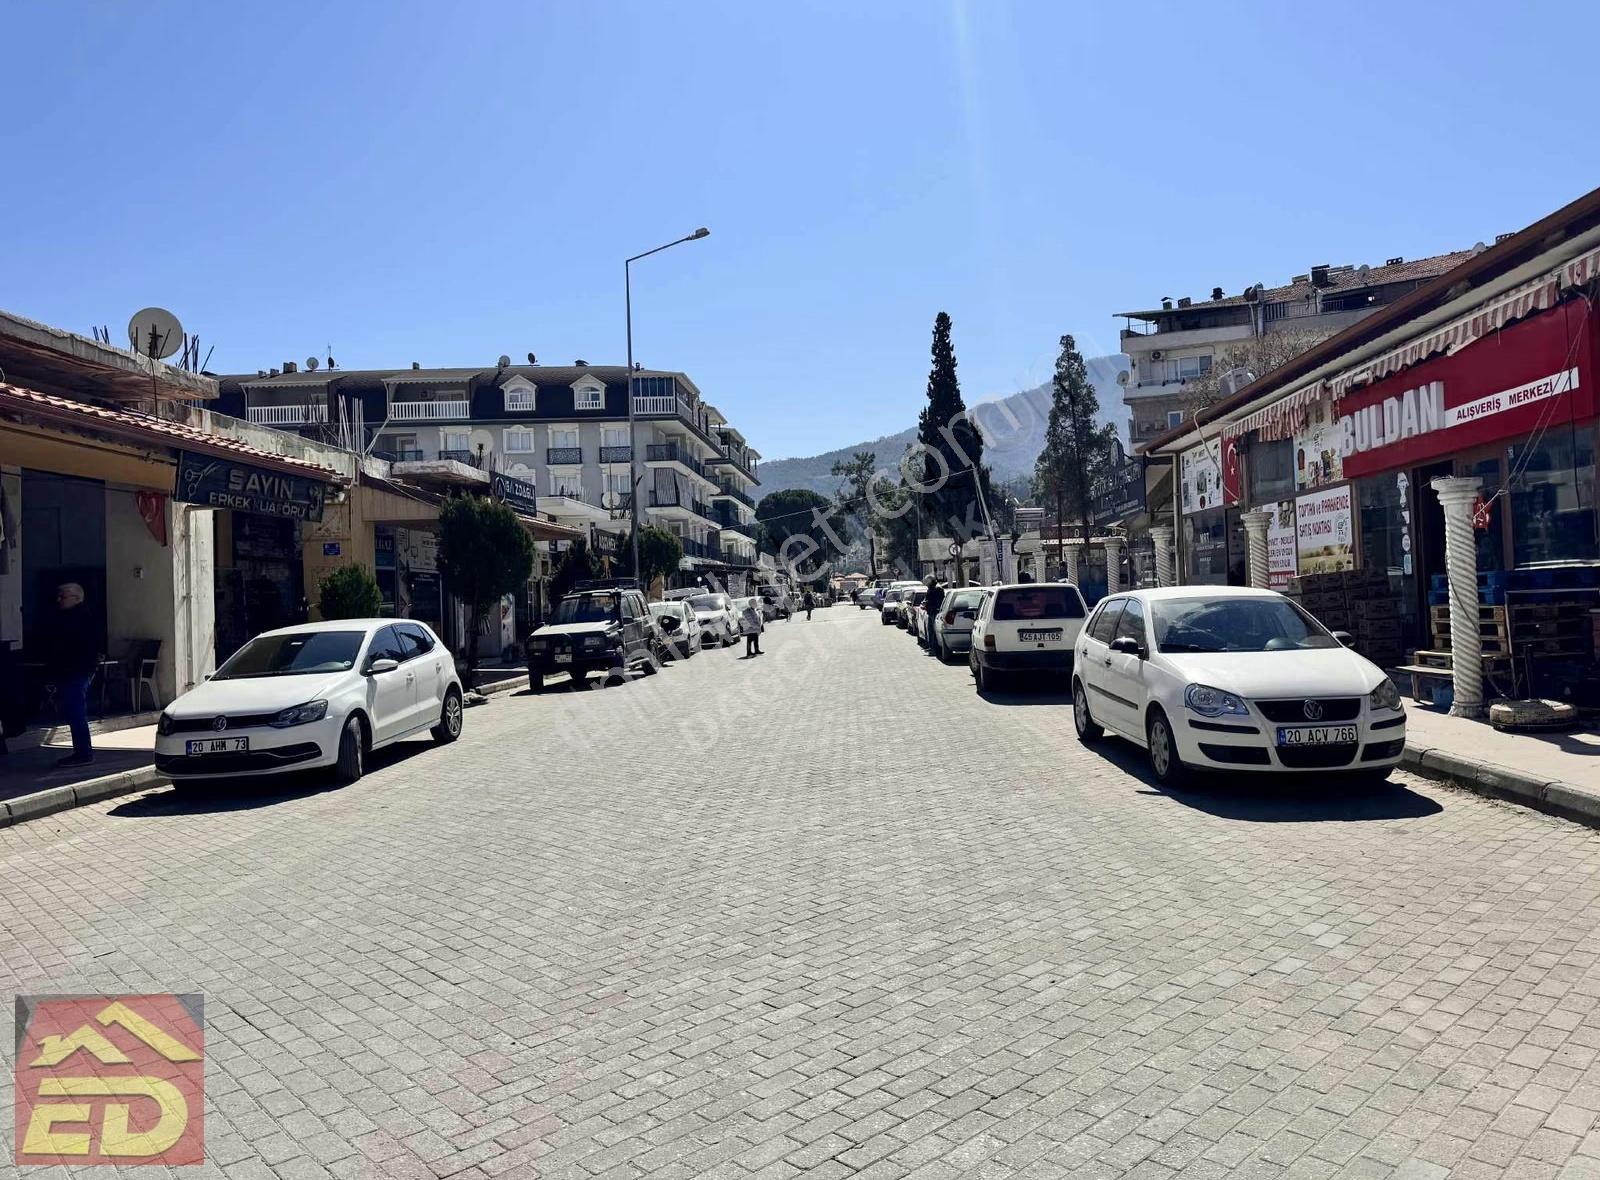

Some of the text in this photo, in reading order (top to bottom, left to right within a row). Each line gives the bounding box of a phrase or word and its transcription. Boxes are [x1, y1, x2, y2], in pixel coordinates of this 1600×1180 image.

[1456, 378, 1553, 421] ALIŞVERİŞ MERKEZİ
[1340, 381, 1444, 459] BULDAN
[228, 469, 294, 500] SAYIN
[209, 492, 250, 508] ERKEK
[1023, 632, 1033, 641] 45
[1047, 632, 1060, 641] 105
[1286, 728, 1355, 742] 20 ACV 766
[192, 742, 204, 753] 20
[235, 739, 246, 750] 73
